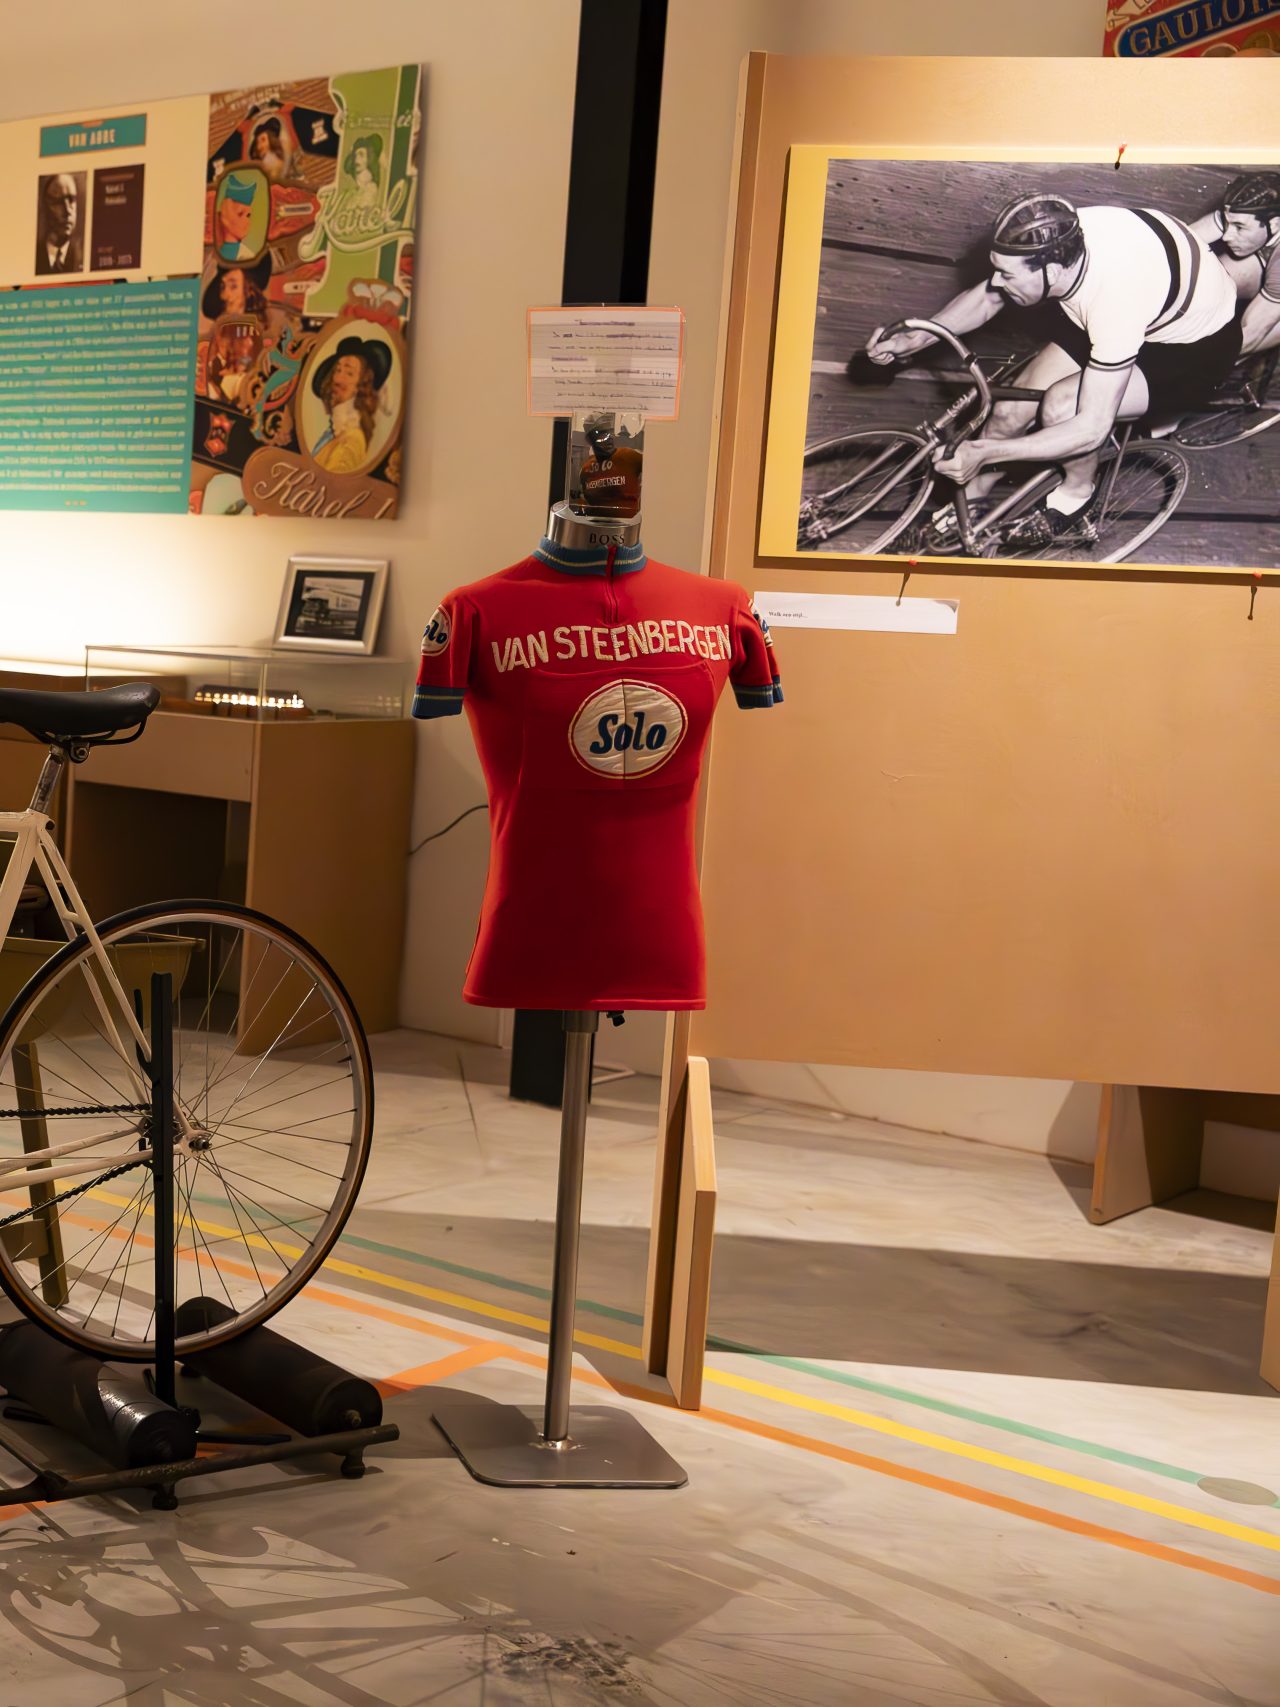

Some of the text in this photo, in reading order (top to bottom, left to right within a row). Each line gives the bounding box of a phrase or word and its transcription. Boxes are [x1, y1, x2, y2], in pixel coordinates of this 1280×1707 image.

[253, 462, 370, 520] Karel
[491, 630, 549, 673] VAN
[554, 620, 731, 661] STEENBERGEN
[589, 712, 667, 755] Solo
